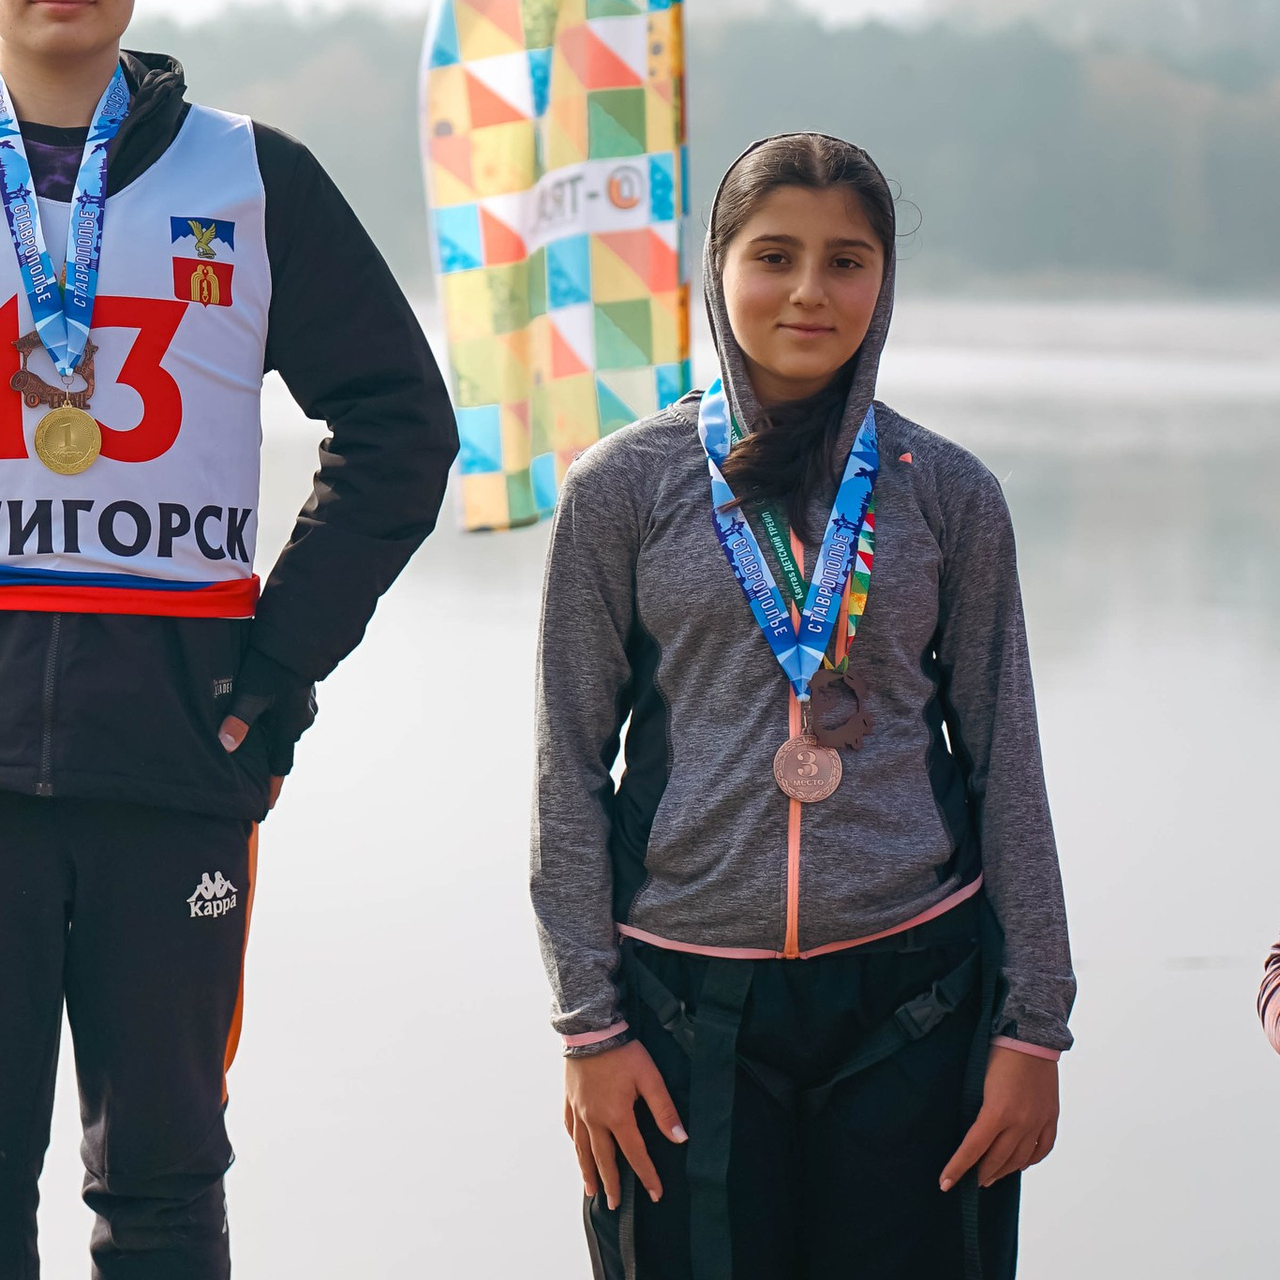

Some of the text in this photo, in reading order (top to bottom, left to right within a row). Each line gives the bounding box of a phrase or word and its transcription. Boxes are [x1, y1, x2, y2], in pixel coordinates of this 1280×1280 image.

[14, 204, 51, 303] СТАВРОПОЛЬЕ
[73, 210, 96, 308] СТАВРОПОЛЬЕ
[732, 537, 788, 637] СТАВРОПОЛЬЕ
[807, 533, 849, 633] СТАВРОПОЛЬЕ
[797, 751, 819, 777] 3
[189, 894, 237, 918] Kappa
